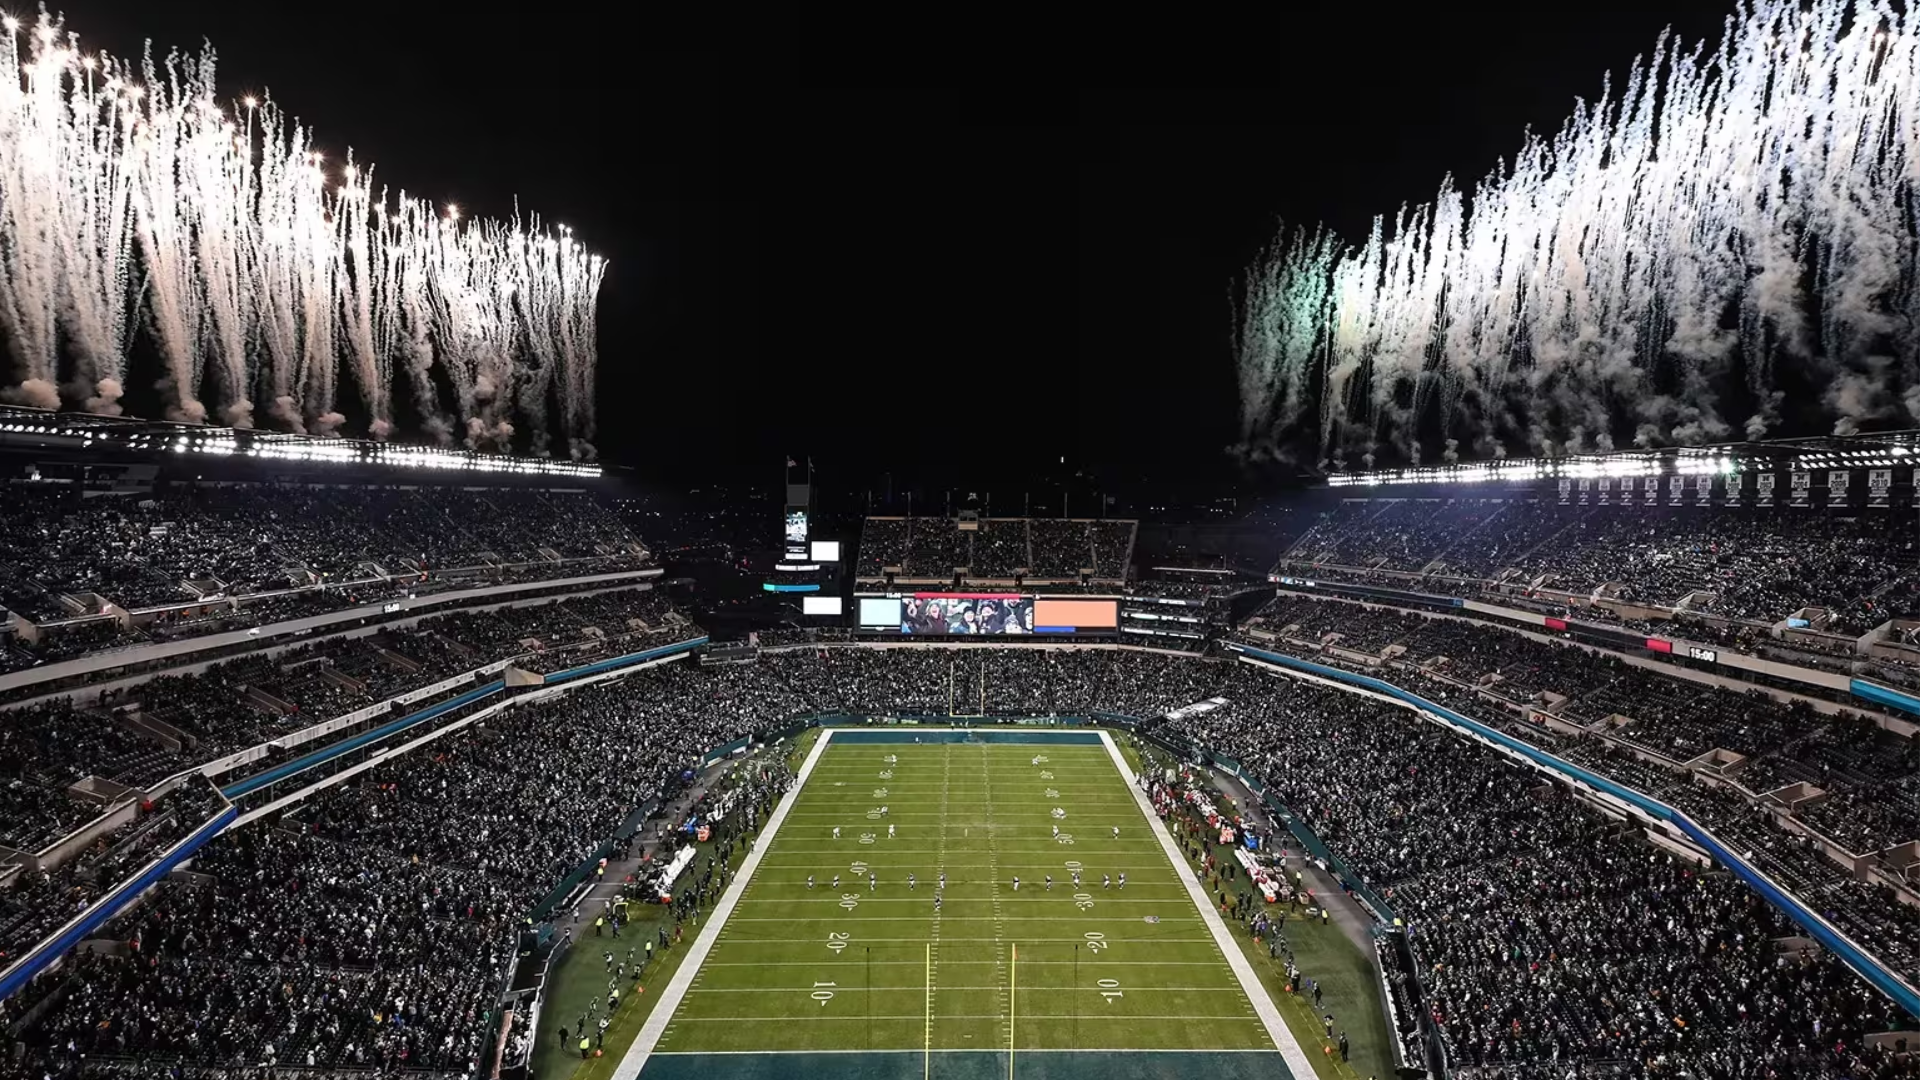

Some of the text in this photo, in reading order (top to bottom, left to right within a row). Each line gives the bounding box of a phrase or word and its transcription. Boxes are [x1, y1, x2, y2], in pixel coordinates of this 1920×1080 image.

[1690, 647, 1715, 662] 15:00
[838, 893, 860, 908] 30
[1073, 893, 1094, 908] 30
[826, 932, 850, 949] 20
[1084, 932, 1108, 949] 20
[811, 981, 836, 1000] 10
[1096, 978, 1123, 998] 10
